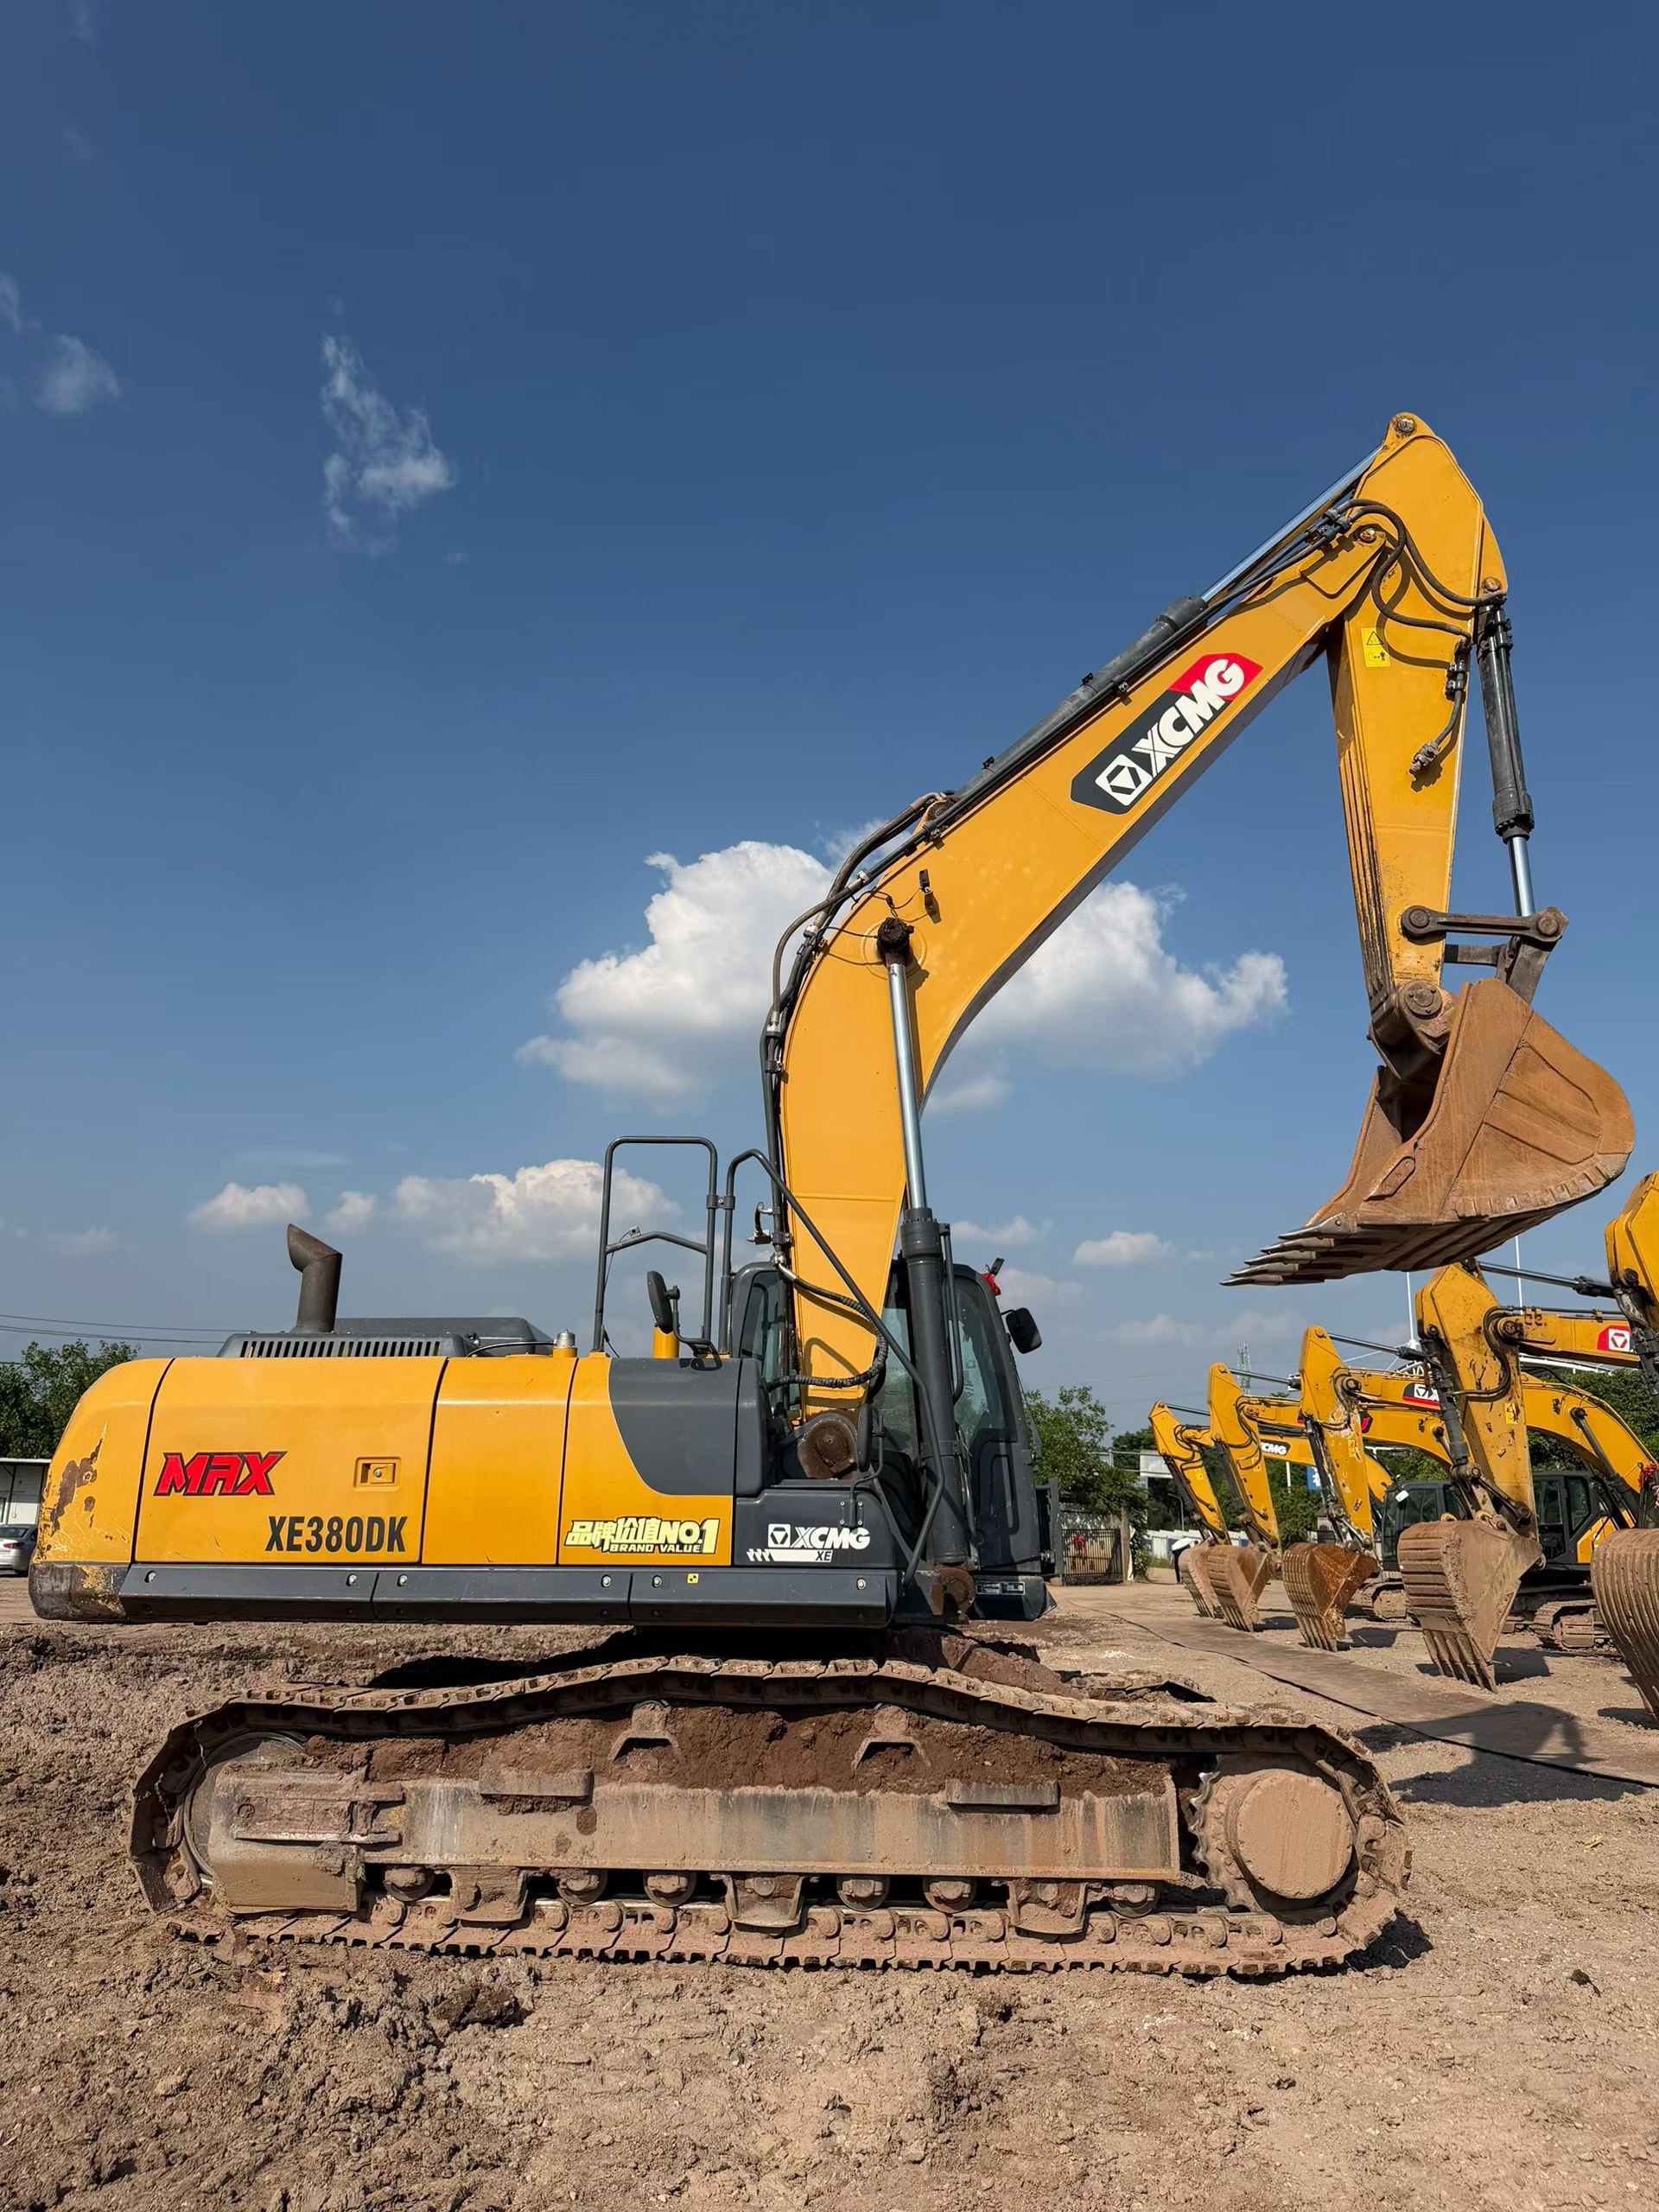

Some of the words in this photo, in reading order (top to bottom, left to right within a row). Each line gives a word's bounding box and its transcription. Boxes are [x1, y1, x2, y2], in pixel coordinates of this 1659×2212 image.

[1131, 658, 1245, 779] XCMG
[1260, 1441, 1287, 1456] CMG
[154, 1452, 288, 1497] MAX
[265, 1516, 408, 1553] XE380DK
[790, 1527, 871, 1549] XCMG
[609, 1543, 654, 1553] BRAND
[659, 1544, 702, 1554] VALUE
[816, 1551, 832, 1561] XE
